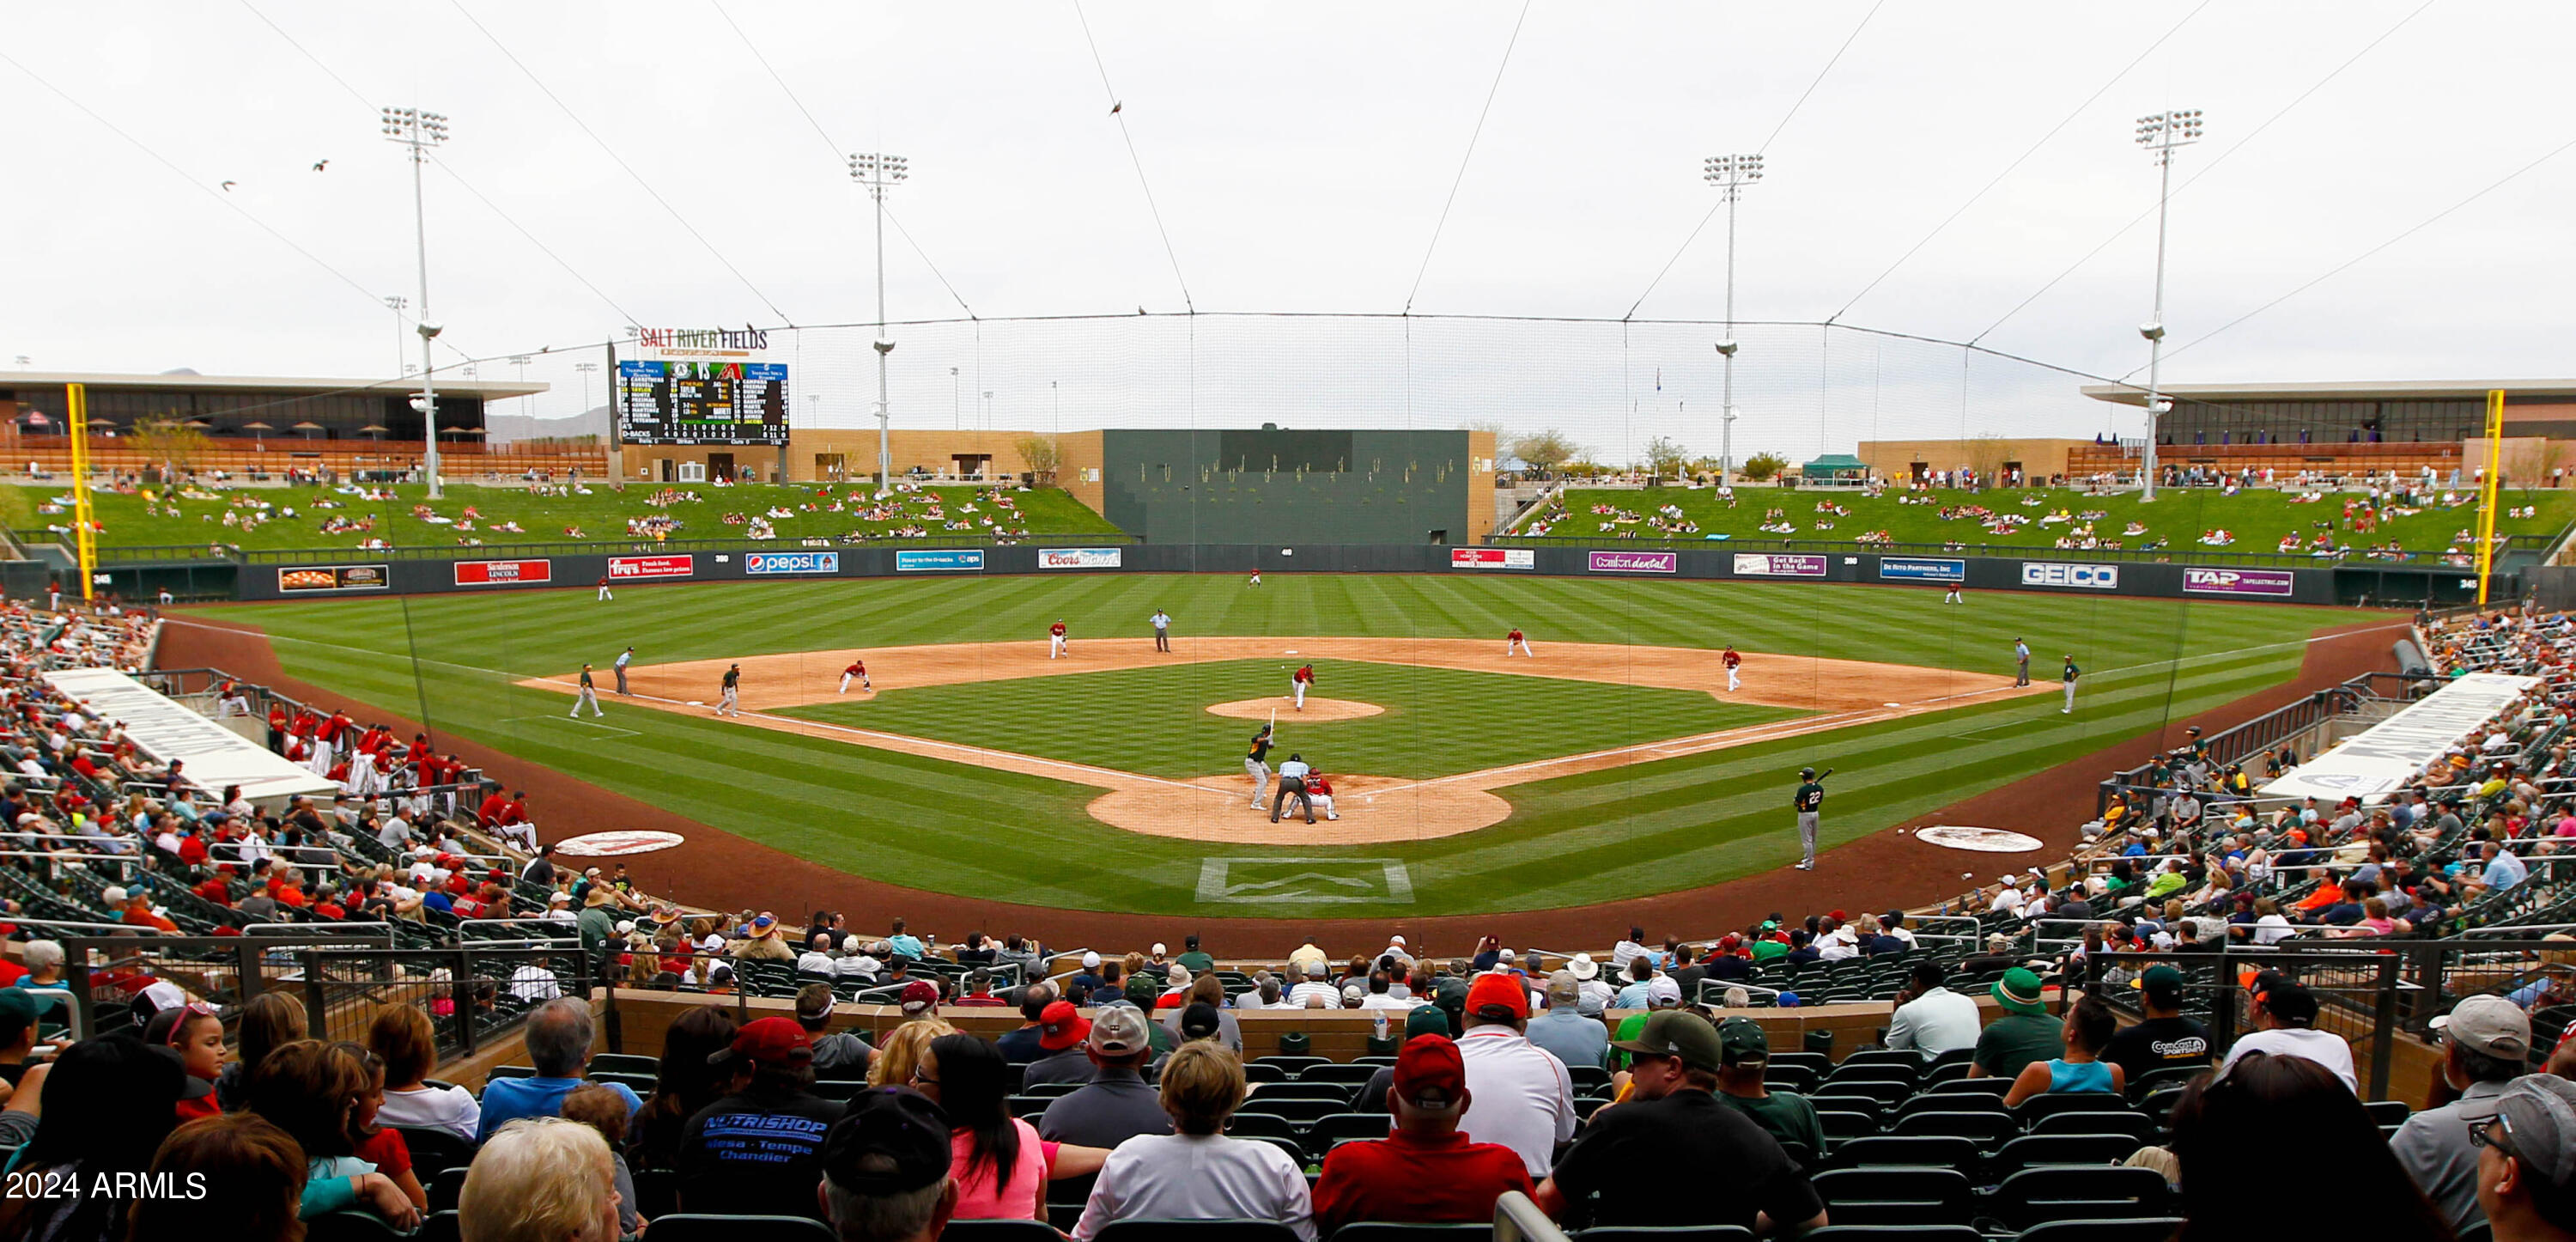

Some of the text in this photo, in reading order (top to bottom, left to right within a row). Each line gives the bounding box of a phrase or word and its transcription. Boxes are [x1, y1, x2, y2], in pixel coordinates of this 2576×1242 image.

[640, 328, 767, 350] SALT RIVER FIELDS
[697, 362, 711, 381] VS
[767, 554, 813, 571] pepsi
[1048, 552, 1080, 565] Coors
[1596, 555, 1668, 569] Comfort dental
[611, 559, 639, 575] fry's
[93, 574, 112, 584] 345
[2024, 564, 2117, 587] GEICO
[2186, 570, 2241, 585] TAP
[2459, 579, 2478, 589] 345
[1809, 791, 1821, 804] 22
[704, 1116, 828, 1132] NUTRISHOP
[759, 1141, 813, 1154] Tempe
[720, 1150, 792, 1163] Chandler
